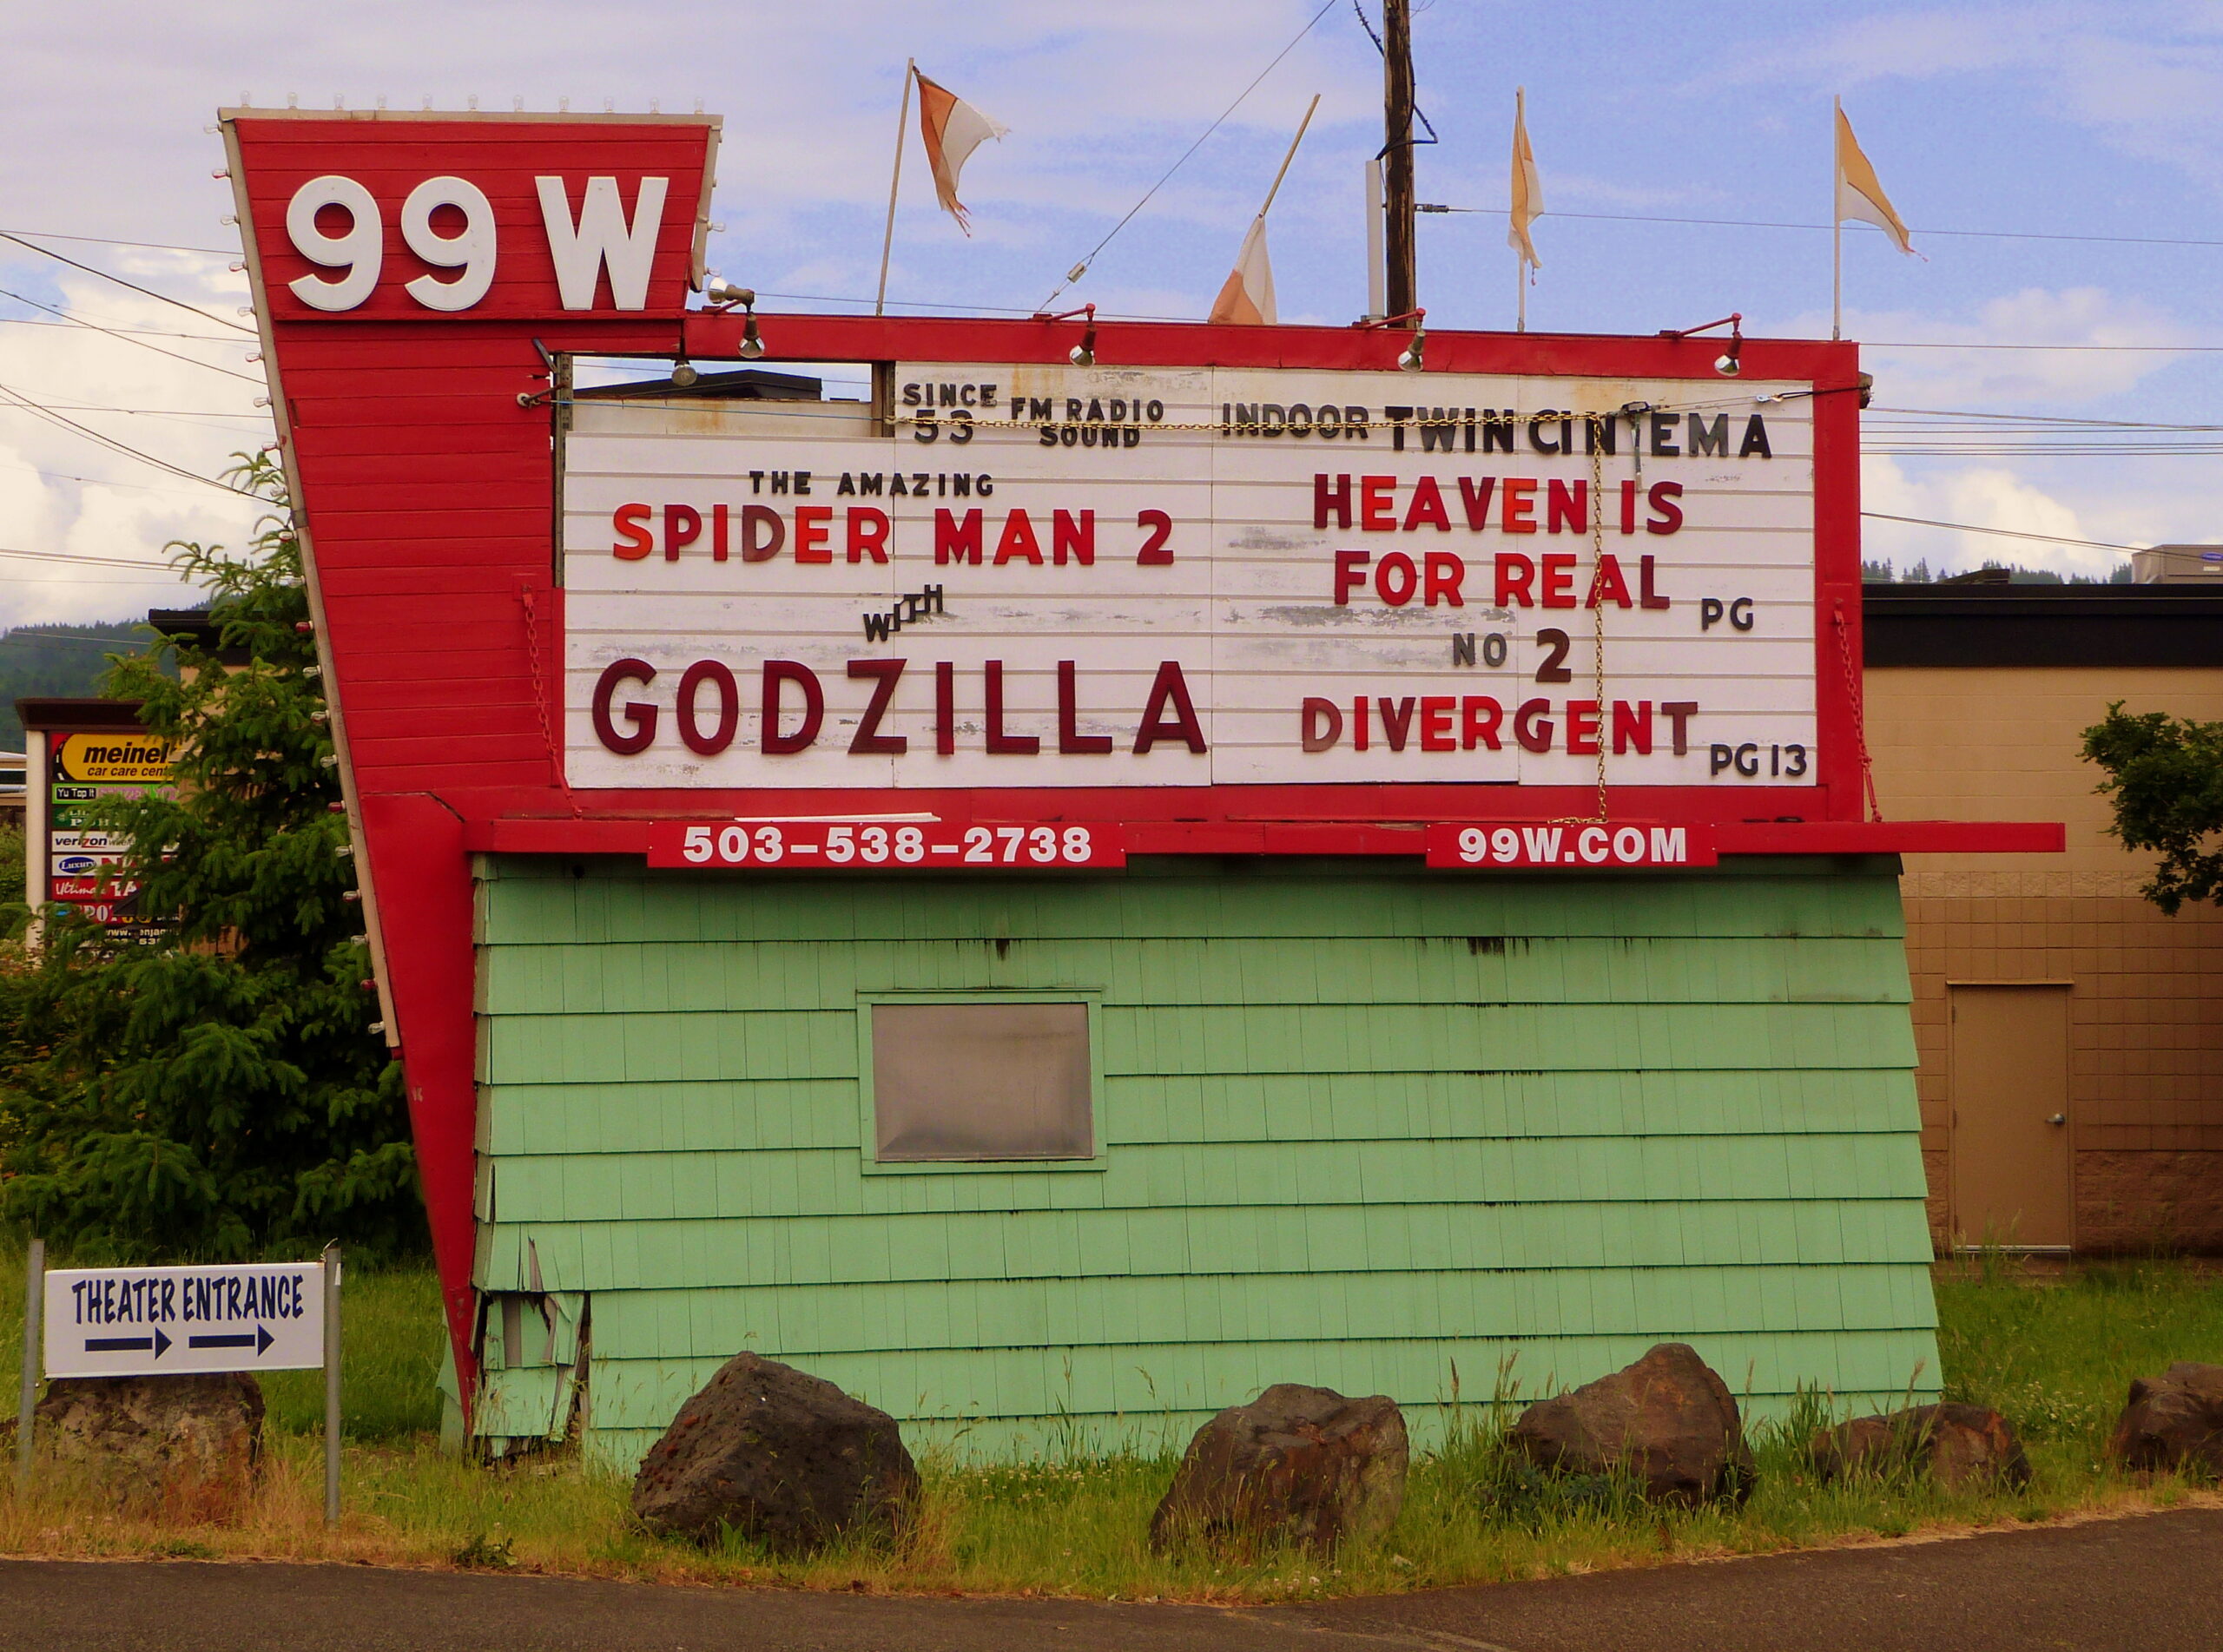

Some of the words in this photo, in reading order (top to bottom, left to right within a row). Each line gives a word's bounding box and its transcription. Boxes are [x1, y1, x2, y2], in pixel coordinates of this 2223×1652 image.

[903, 383, 997, 406] SINCE
[1012, 397, 1053, 420] FM
[1066, 398, 1164, 422] RADIO
[915, 409, 974, 444] 53
[1040, 425, 1141, 447] SOUND
[1222, 403, 1369, 438] INDOOR
[1384, 406, 1514, 452] TWIN
[749, 471, 811, 495] THE
[837, 471, 993, 497] AMAZING
[1314, 473, 1588, 534] HEAVEN
[1621, 480, 1683, 535] IS
[613, 503, 890, 563] SPIDER
[934, 508, 1095, 565] MAN
[1137, 509, 1174, 565] 2
[1334, 550, 1465, 606] FOR
[1494, 552, 1670, 609] REAL
[1701, 597, 1754, 631] PG
[863, 583, 943, 642] WITH
[1453, 632, 1507, 667] NO
[1535, 628, 1571, 682] 2
[592, 658, 1207, 755] GODZILLA
[1303, 695, 1698, 755] DIVERGENT
[88, 767, 108, 776] car
[110, 767, 137, 776] care
[58, 788, 69, 798] Yu
[55, 837, 107, 846] verizon
[683, 826, 1092, 863] 503-538-2738
[1459, 826, 1686, 862] 99W.COM
[61, 860, 96, 870] Luxury
[72, 1277, 175, 1324] THEATER
[183, 1274, 303, 1321] ENTRANCE
